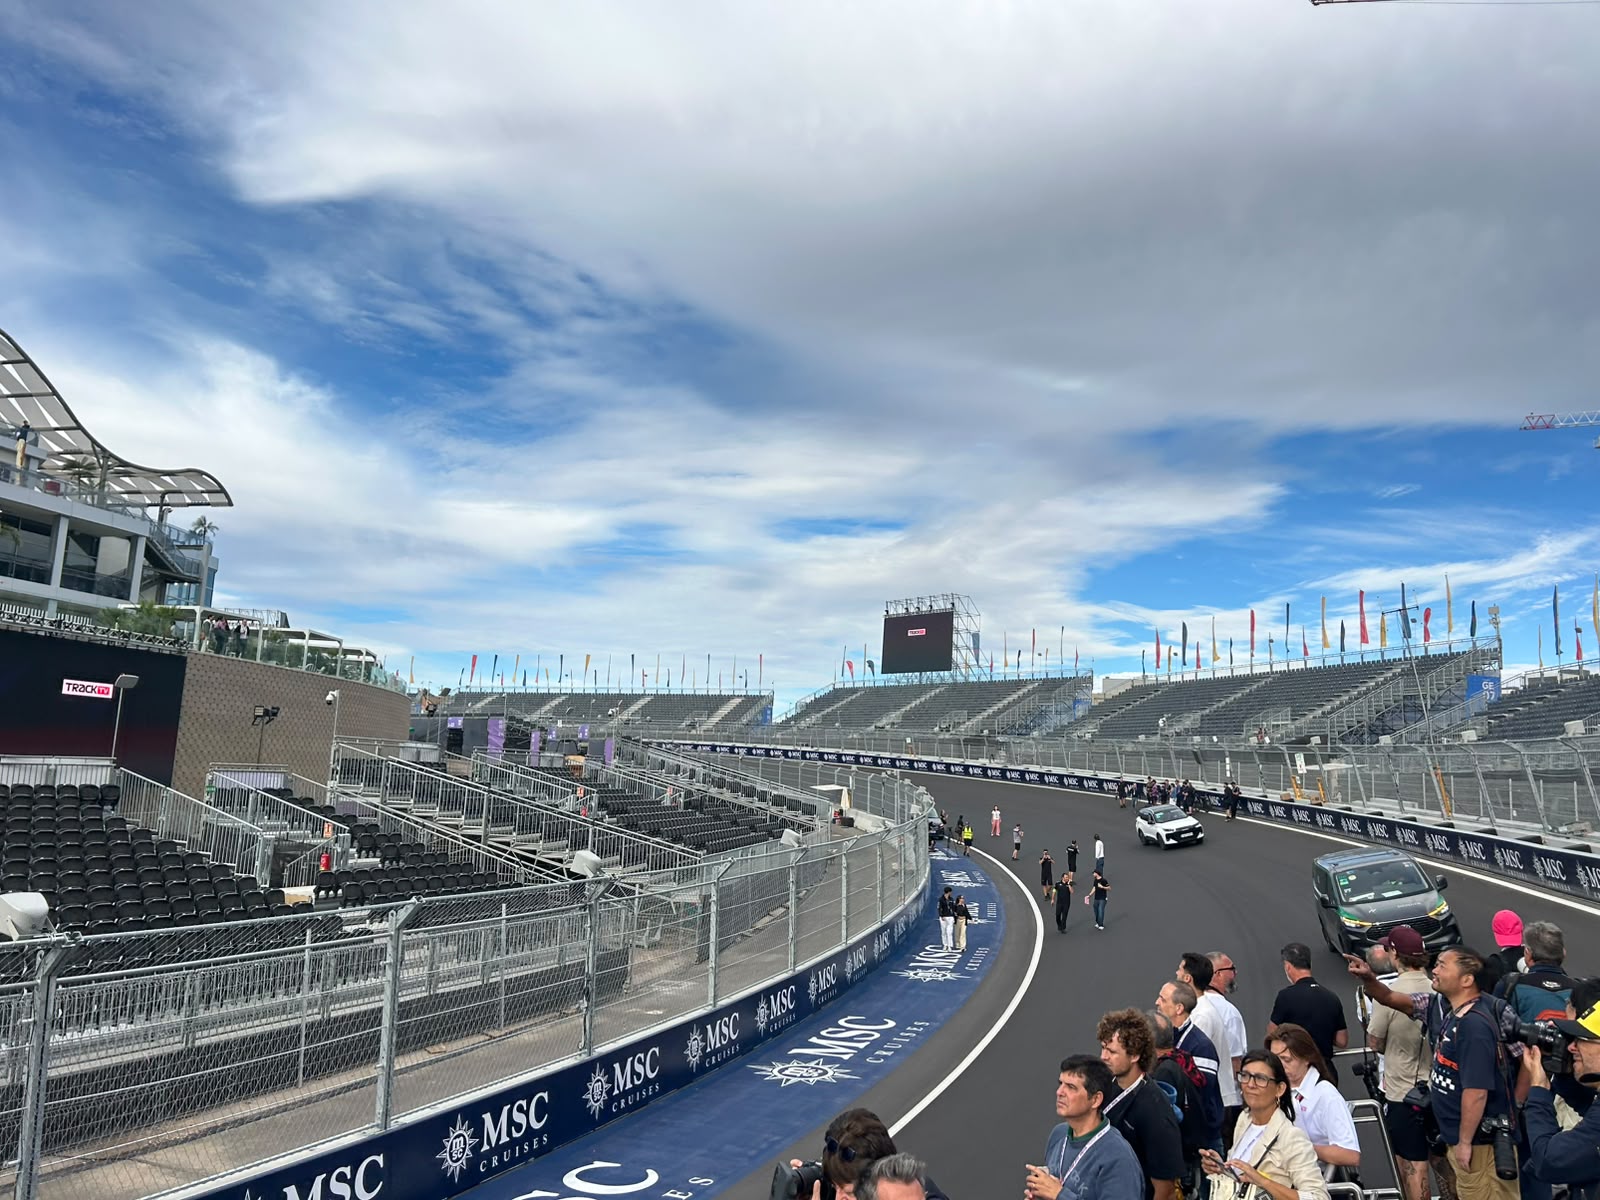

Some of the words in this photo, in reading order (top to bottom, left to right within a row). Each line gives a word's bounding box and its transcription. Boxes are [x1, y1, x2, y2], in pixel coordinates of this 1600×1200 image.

[98, 686, 110, 695] TV
[1482, 681, 1495, 690] GE
[1251, 801, 1264, 813] MSC
[1273, 804, 1286, 817] MSC
[1296, 809, 1310, 822] MSC
[1320, 813, 1335, 827] MSC
[1345, 818, 1361, 832] MSC
[1372, 822, 1388, 838] MSC
[1401, 827, 1419, 845] MSC
[1430, 834, 1450, 852] MSC
[1465, 840, 1486, 860] MSC
[1501, 848, 1523, 869] MSC
[1541, 857, 1567, 880] MSC
[853, 945, 867, 971] MSC
[909, 945, 962, 969] MSC
[818, 963, 837, 993] MSC
[770, 984, 796, 1020] MSC
[705, 1012, 739, 1053] MSC
[769, 1013, 796, 1033] CRUISES
[787, 1015, 896, 1060] MSC
[865, 1021, 930, 1064] CRUISES
[705, 1043, 740, 1067] CRUISES
[612, 1046, 660, 1096] MSC
[612, 1083, 660, 1112] CRUISES
[480, 1091, 549, 1153] MSC
[480, 1133, 548, 1172] CRUISES
